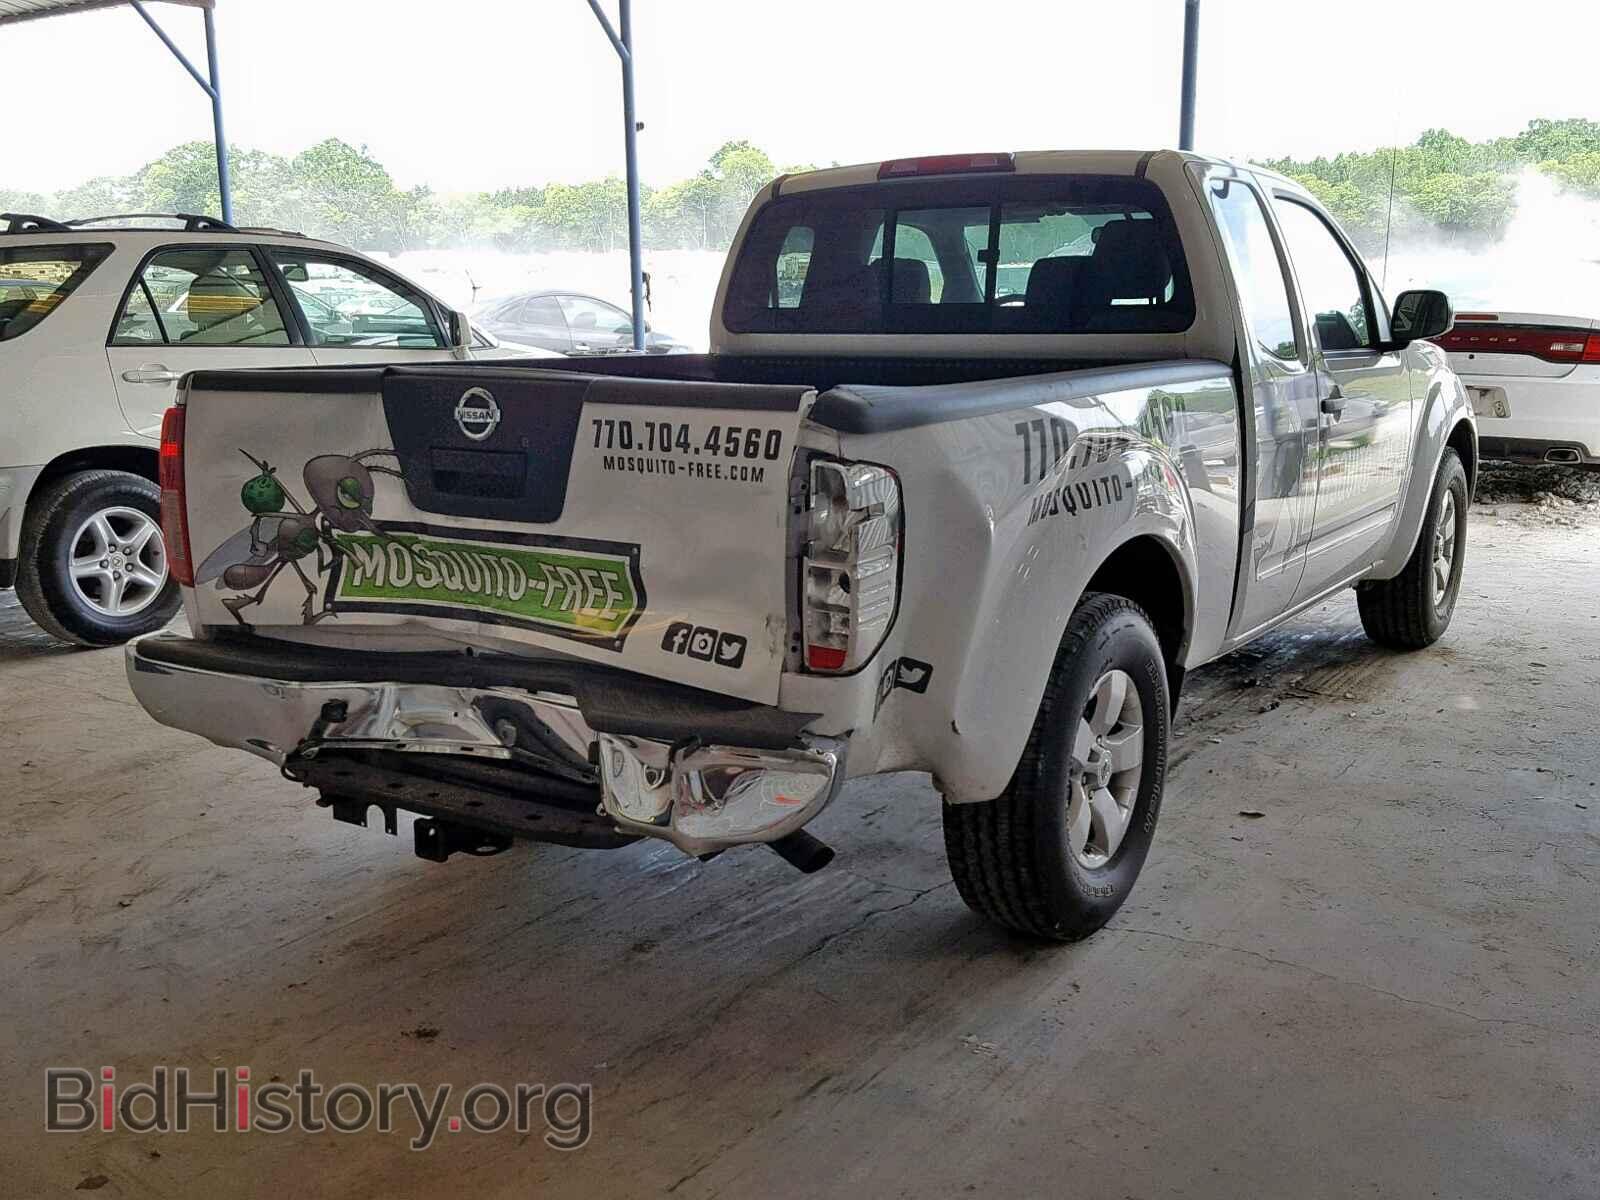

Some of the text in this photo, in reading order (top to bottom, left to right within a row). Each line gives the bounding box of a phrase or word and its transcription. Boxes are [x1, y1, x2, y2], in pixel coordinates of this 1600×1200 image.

[456, 409, 495, 420] NISSAN
[592, 419, 782, 460] 770.704.4560
[603, 455, 765, 483] MOSQUITO-FREE.COM
[350, 541, 624, 620] MOSQUITO-FREE
